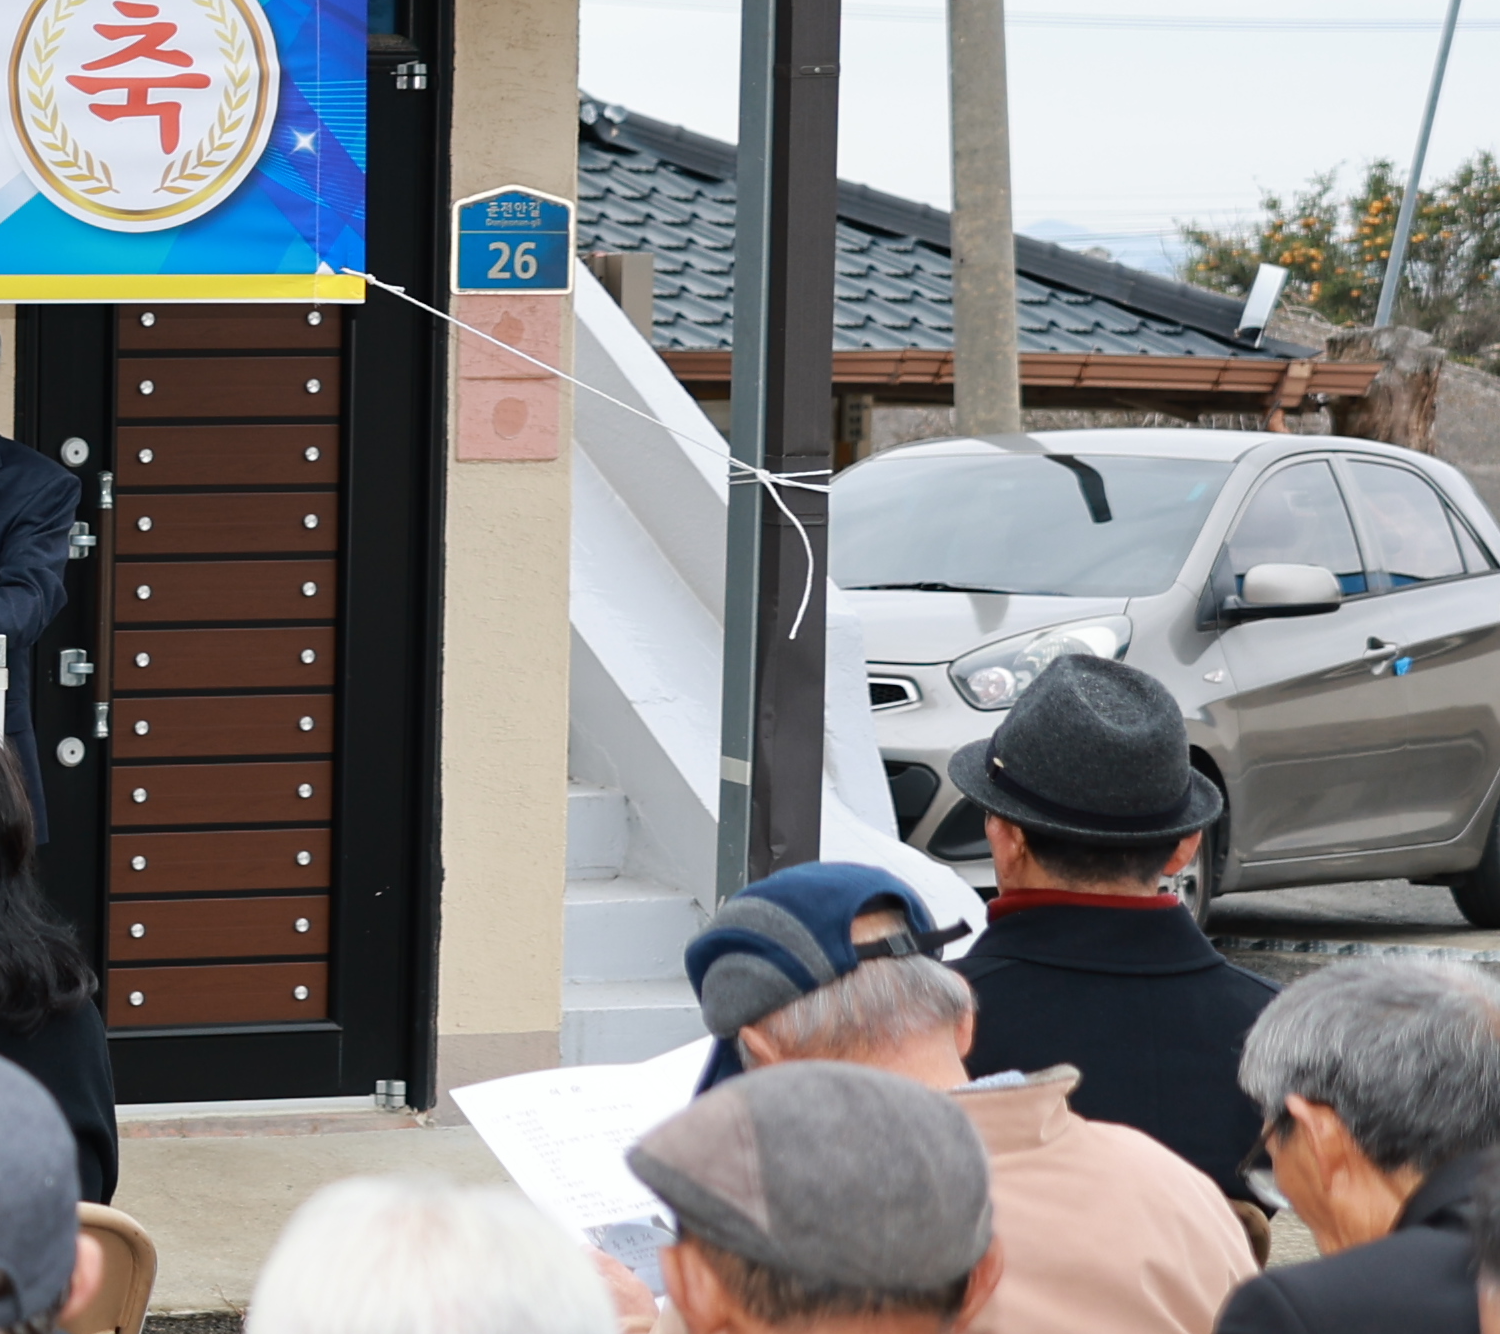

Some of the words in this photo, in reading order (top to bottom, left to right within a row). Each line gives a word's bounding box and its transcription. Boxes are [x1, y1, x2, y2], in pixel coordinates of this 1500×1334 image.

[65, 1, 211, 155] 축
[486, 201, 540, 218] 둔전안길
[487, 241, 538, 280] 26
